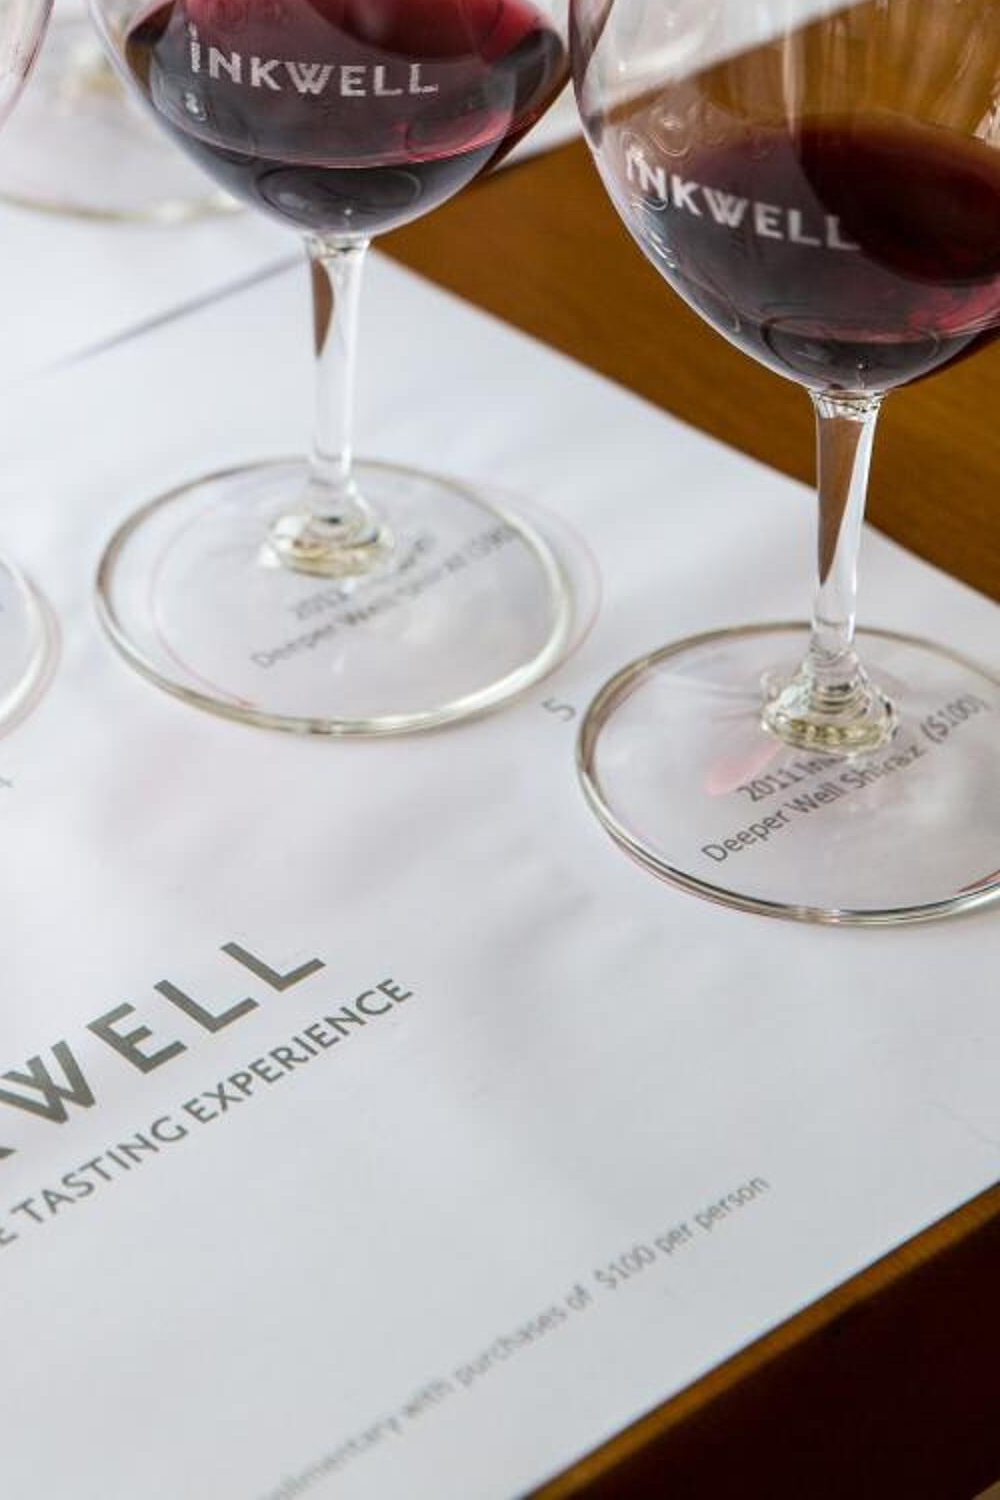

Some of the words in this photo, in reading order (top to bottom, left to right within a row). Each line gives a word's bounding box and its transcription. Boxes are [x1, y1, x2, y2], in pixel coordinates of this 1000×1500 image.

[188, 36, 439, 97] INKWELL
[626, 145, 861, 251] INKWELL
[542, 696, 577, 723] 5
[701, 808, 791, 863] Deeper
[788, 780, 841, 815] Well
[838, 743, 925, 791] Shiraz
[919, 692, 990, 744] ($100)
[737, 766, 801, 803] 2011
[12, 1116, 188, 1225] TASTING
[182, 977, 413, 1125] EXPERIENCE
[455, 1306, 568, 1388] purchases
[565, 1283, 593, 1312] of
[594, 1245, 656, 1290] $100
[653, 1221, 693, 1255] per
[694, 1175, 771, 1231] person
